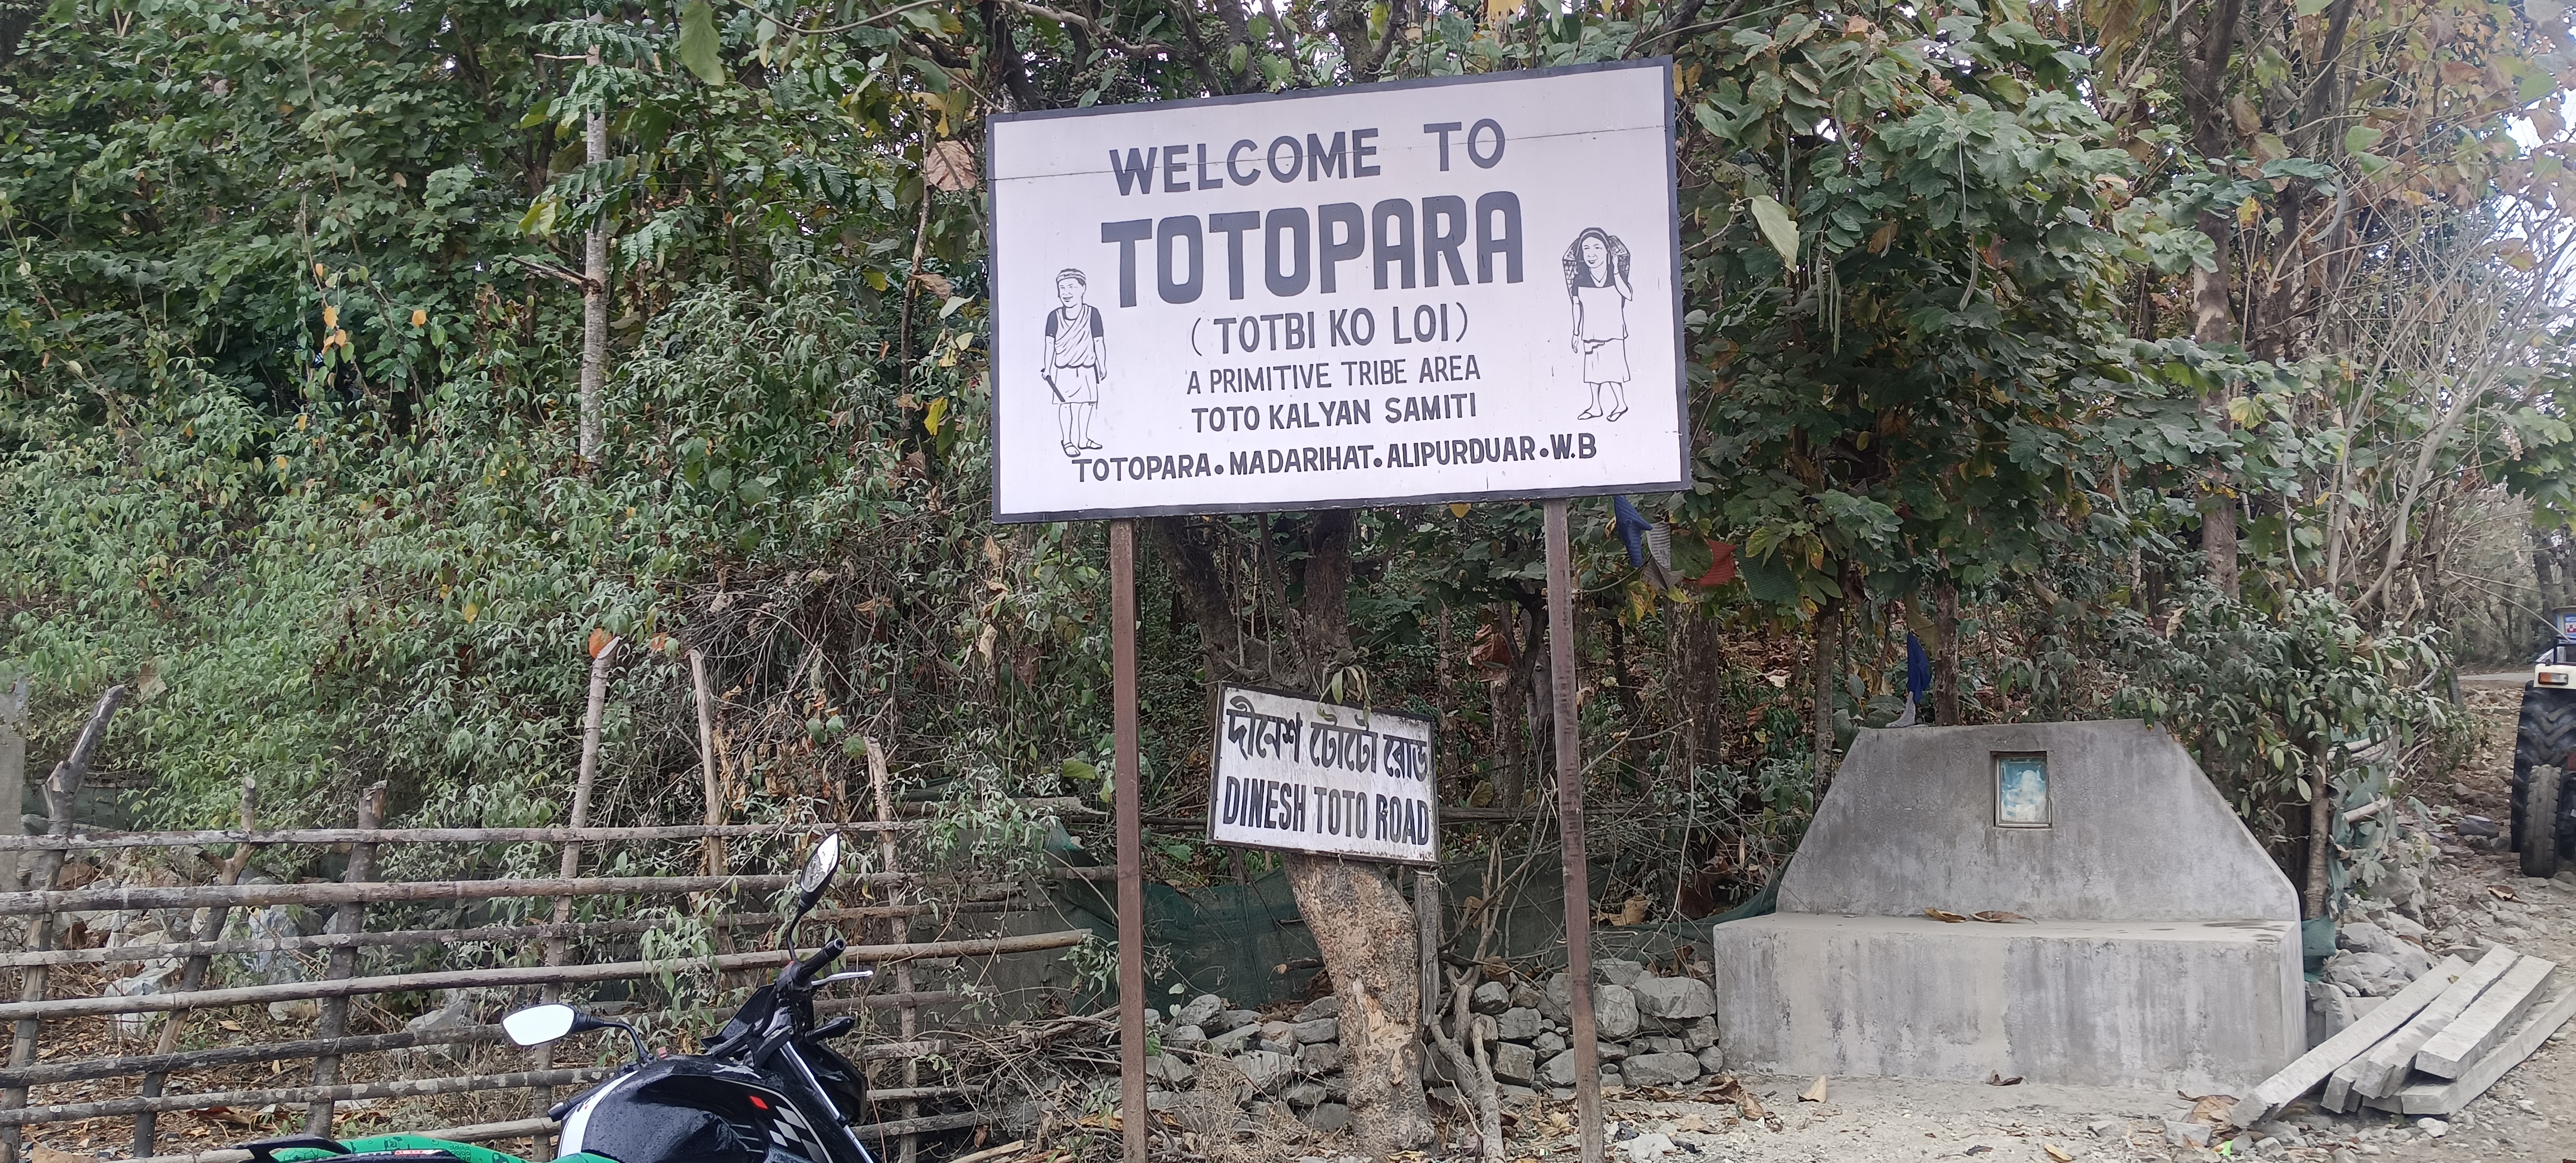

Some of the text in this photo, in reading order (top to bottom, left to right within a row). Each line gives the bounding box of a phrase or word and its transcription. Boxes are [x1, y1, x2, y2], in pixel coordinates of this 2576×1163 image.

[1110, 118, 1505, 196] WELCOME TO
[1101, 191, 1524, 308] TOTOPARA
[1329, 308, 1375, 347] KO
[1186, 354, 1481, 395] A PRIMITIVE TRIBE AREA
[1191, 392, 1476, 433] TOTO KALYAN SAMITI
[1226, 695, 1428, 782] দীনেশ টোটো রোড
[1223, 776, 1429, 845] DINESH TOTO ROAD
